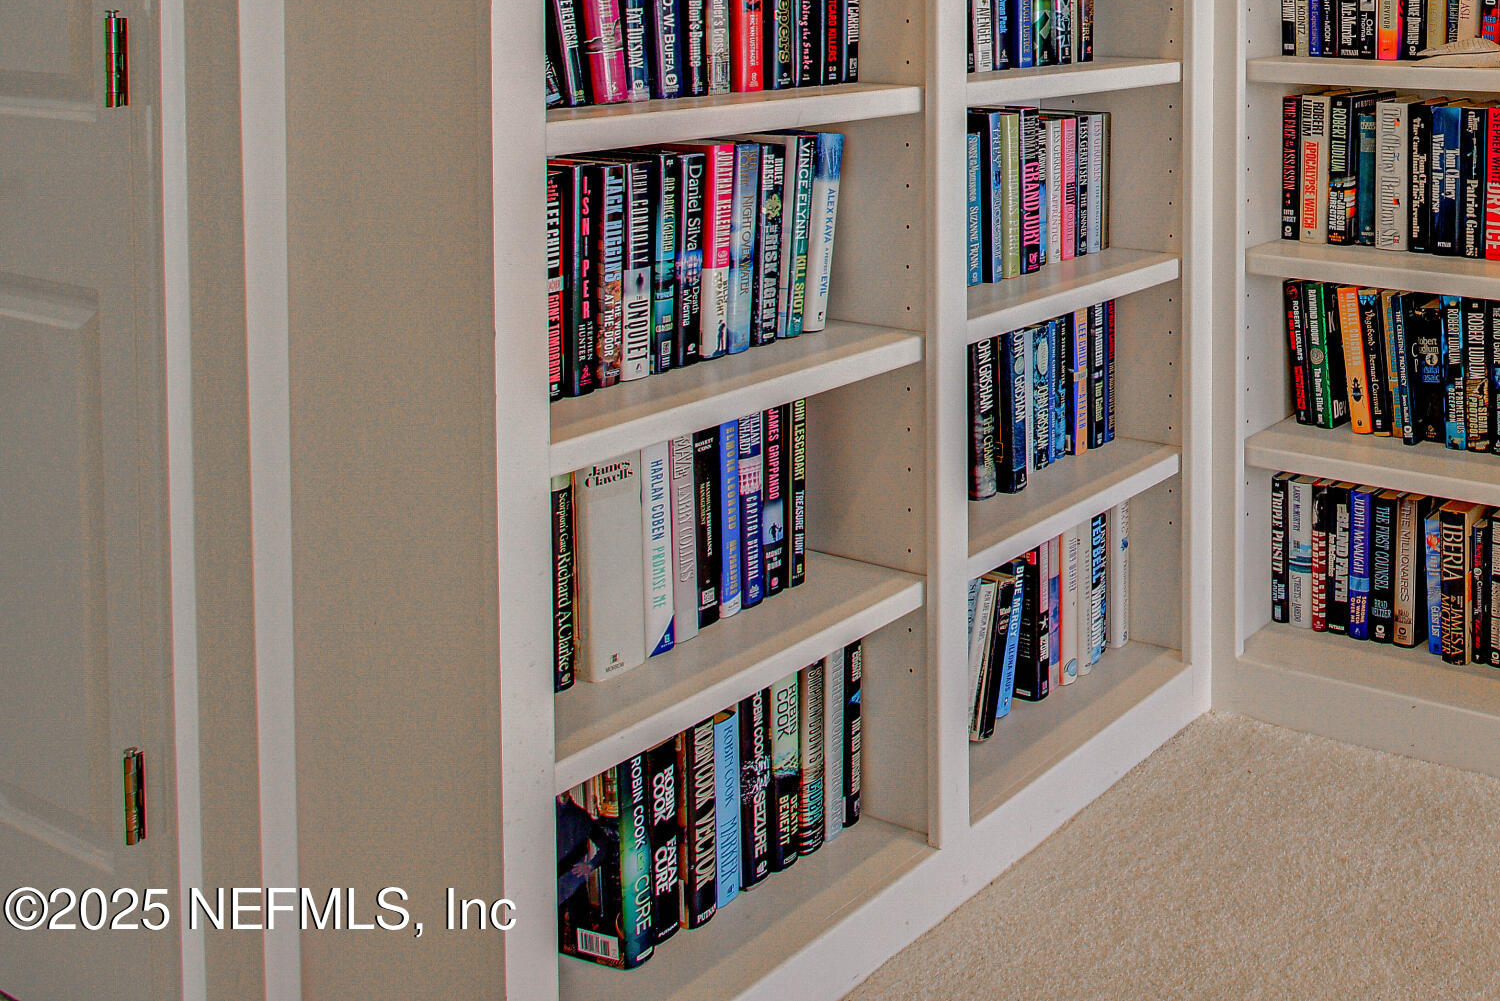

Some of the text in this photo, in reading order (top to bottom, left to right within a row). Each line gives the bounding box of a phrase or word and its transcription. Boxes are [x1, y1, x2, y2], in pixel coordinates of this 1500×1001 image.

[663, 13, 674, 30] W.
[976, 7, 990, 45] AVENGER
[663, 33, 676, 71] BUFFA
[1312, 102, 1324, 137] ROBERT
[1331, 107, 1346, 172] ROBERT LUDLUM
[797, 142, 810, 189] VINCE
[687, 164, 701, 250] Daniel Silva
[1022, 161, 1040, 246] GRAND JURY
[793, 254, 806, 315] KILL SHOT
[1308, 289, 1319, 345] RAYMOND KHOURY
[1468, 313, 1485, 379] ROBERT LUDLUM
[978, 365, 993, 414] GRISHAM
[1369, 354, 1381, 415] Bernard Cornwell
[768, 409, 780, 500] JAMES GRIPPANDO
[794, 425, 805, 480] LESCROART
[1037, 408, 1048, 449] GRISHAM
[651, 460, 664, 541] HARLAN COBEN
[795, 490, 805, 555] TREASURE HUNT
[1374, 507, 1390, 590] THE FIRST COUNSEL
[1400, 506, 1412, 602] THE MILLIONAIRES
[1442, 523, 1464, 581] IBERIA
[1010, 566, 1025, 637] BLUE MERCY
[630, 756, 645, 849] ROBIN COOK
[653, 773, 665, 826] COOK
[663, 764, 676, 819] ROBIN
[778, 795, 790, 845] BENEFIT
[666, 836, 677, 892] FATAL
[634, 874, 651, 935] CURE
